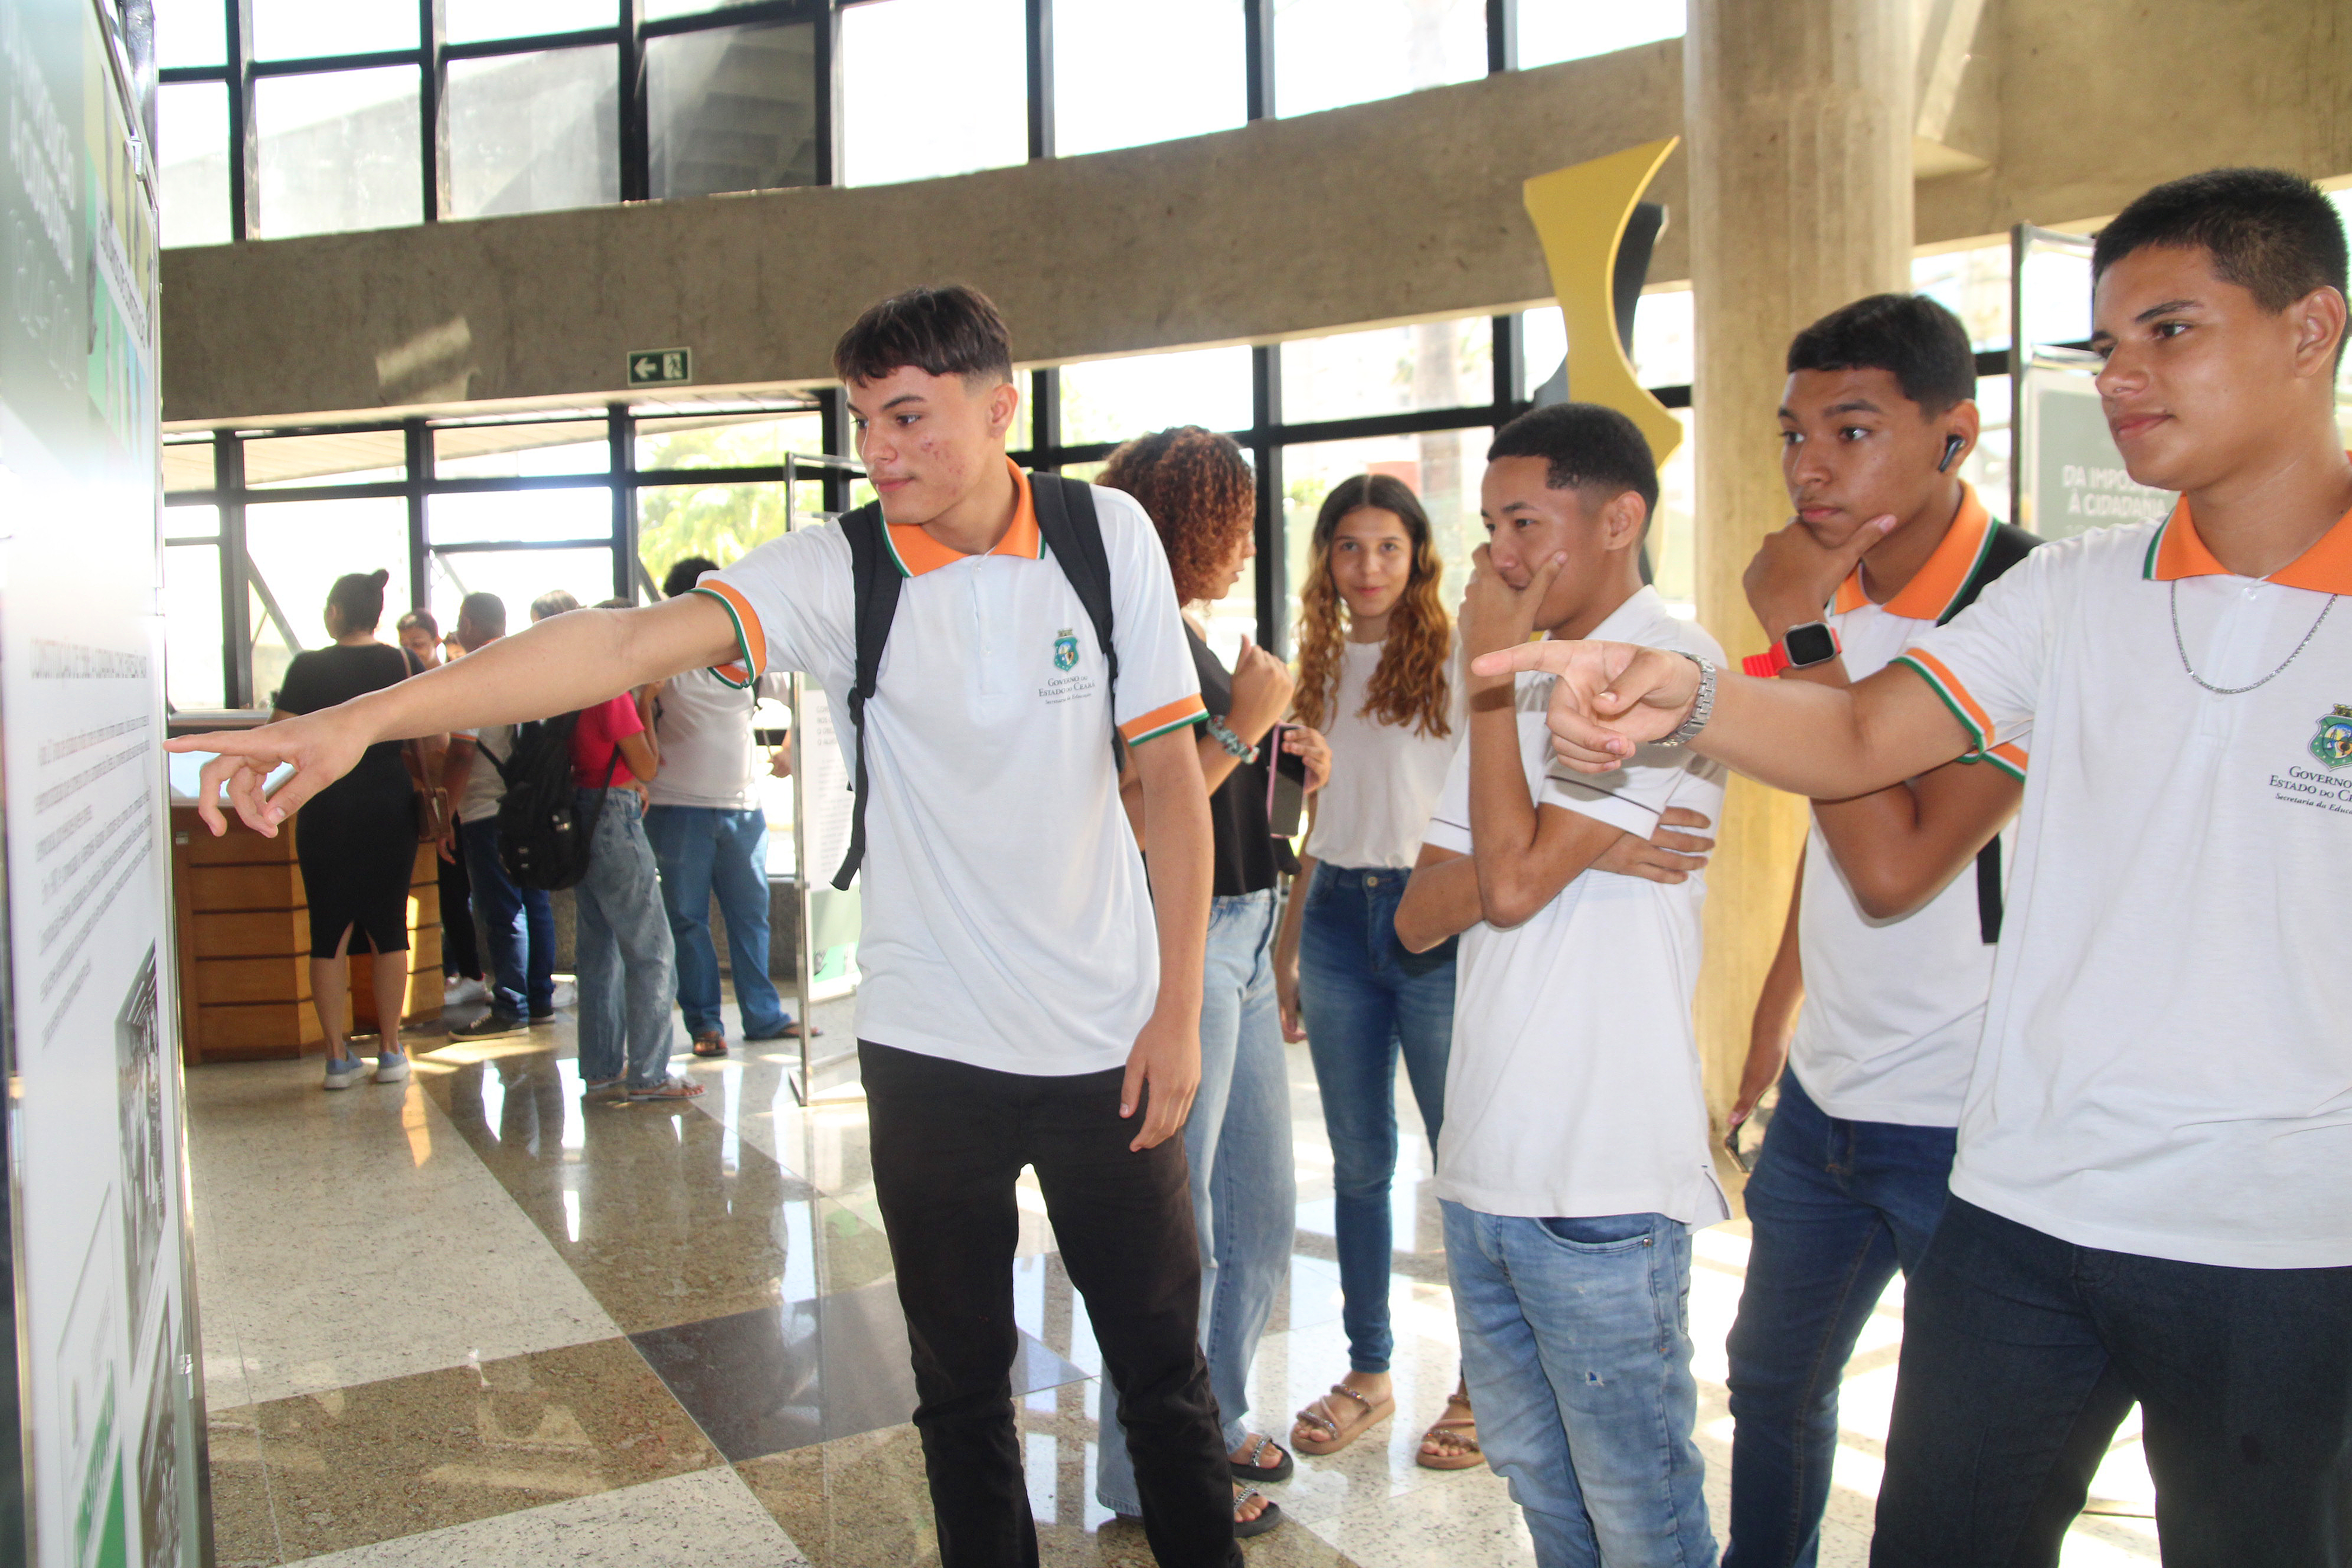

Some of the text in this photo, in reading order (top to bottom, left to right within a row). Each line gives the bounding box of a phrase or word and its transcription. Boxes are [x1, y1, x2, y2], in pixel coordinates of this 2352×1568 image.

[2269, 775, 2317, 794] ESTADO
[2320, 789, 2334, 798] DO
[2289, 766, 2352, 789] GOVERNO
[2276, 792, 2314, 806] Secretaria
